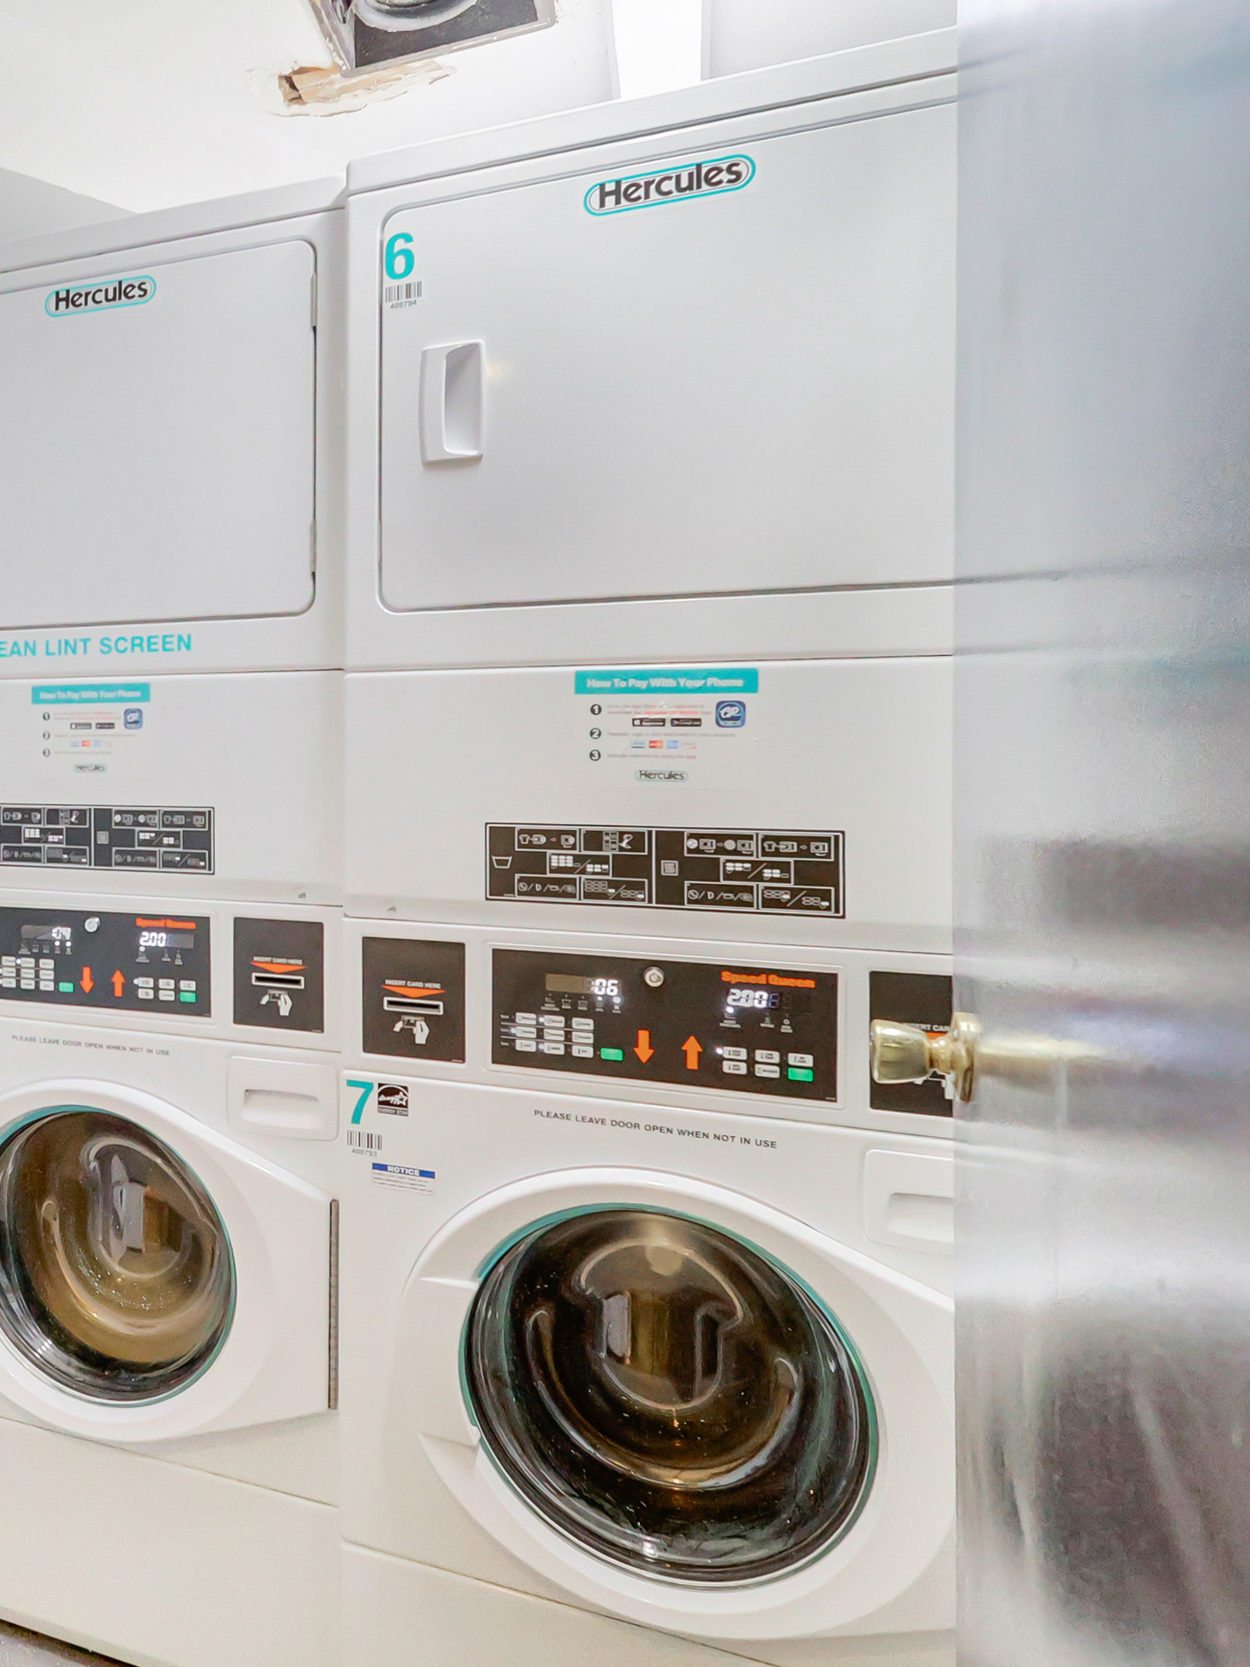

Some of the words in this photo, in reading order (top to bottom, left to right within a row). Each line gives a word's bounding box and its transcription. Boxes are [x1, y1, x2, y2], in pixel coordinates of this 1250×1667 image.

[599, 162, 742, 209] Hercules
[384, 232, 415, 280] 6
[54, 280, 148, 311] Hercules
[45, 637, 92, 656] LINT
[99, 633, 192, 655] SCREEN
[586, 679, 612, 688] How
[613, 678, 626, 688] To
[628, 678, 648, 690] Pay
[650, 677, 677, 688] With
[678, 677, 705, 688] Your
[706, 677, 744, 687] Phone
[639, 770, 684, 780] Hercules
[721, 970, 767, 984] Speed
[768, 974, 816, 988] Queen
[106, 1044, 127, 1052] WHEN
[346, 1079, 374, 1125] 7
[534, 1109, 572, 1121] PLEASE
[575, 1114, 607, 1126] LEAVE
[610, 1119, 641, 1130] DOOR
[644, 1124, 674, 1135] OPEN
[676, 1128, 710, 1140] WHEN
[713, 1133, 736, 1143] NOT
[740, 1137, 751, 1145] IN
[755, 1139, 777, 1149] USE
[387, 1165, 420, 1176] NOTICE
